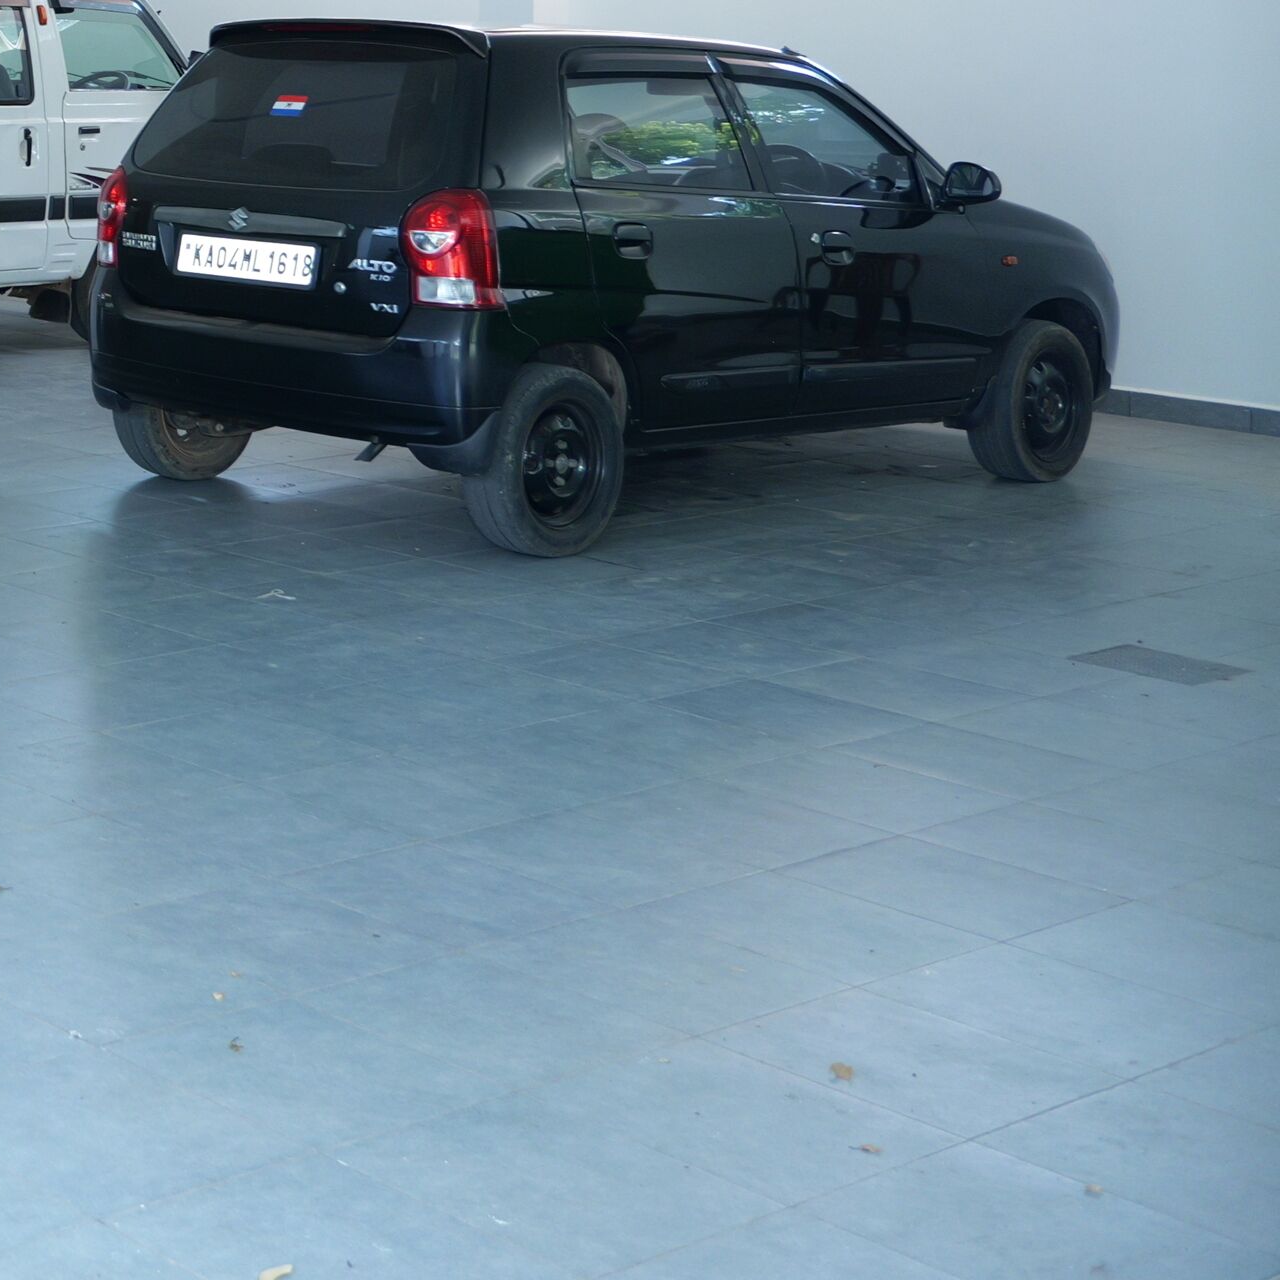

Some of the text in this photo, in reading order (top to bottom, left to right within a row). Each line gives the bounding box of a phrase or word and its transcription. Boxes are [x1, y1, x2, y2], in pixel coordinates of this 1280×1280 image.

[192, 243, 313, 278] KA04ML1618
[347, 258, 397, 274] ALTO
[369, 273, 391, 282] K10
